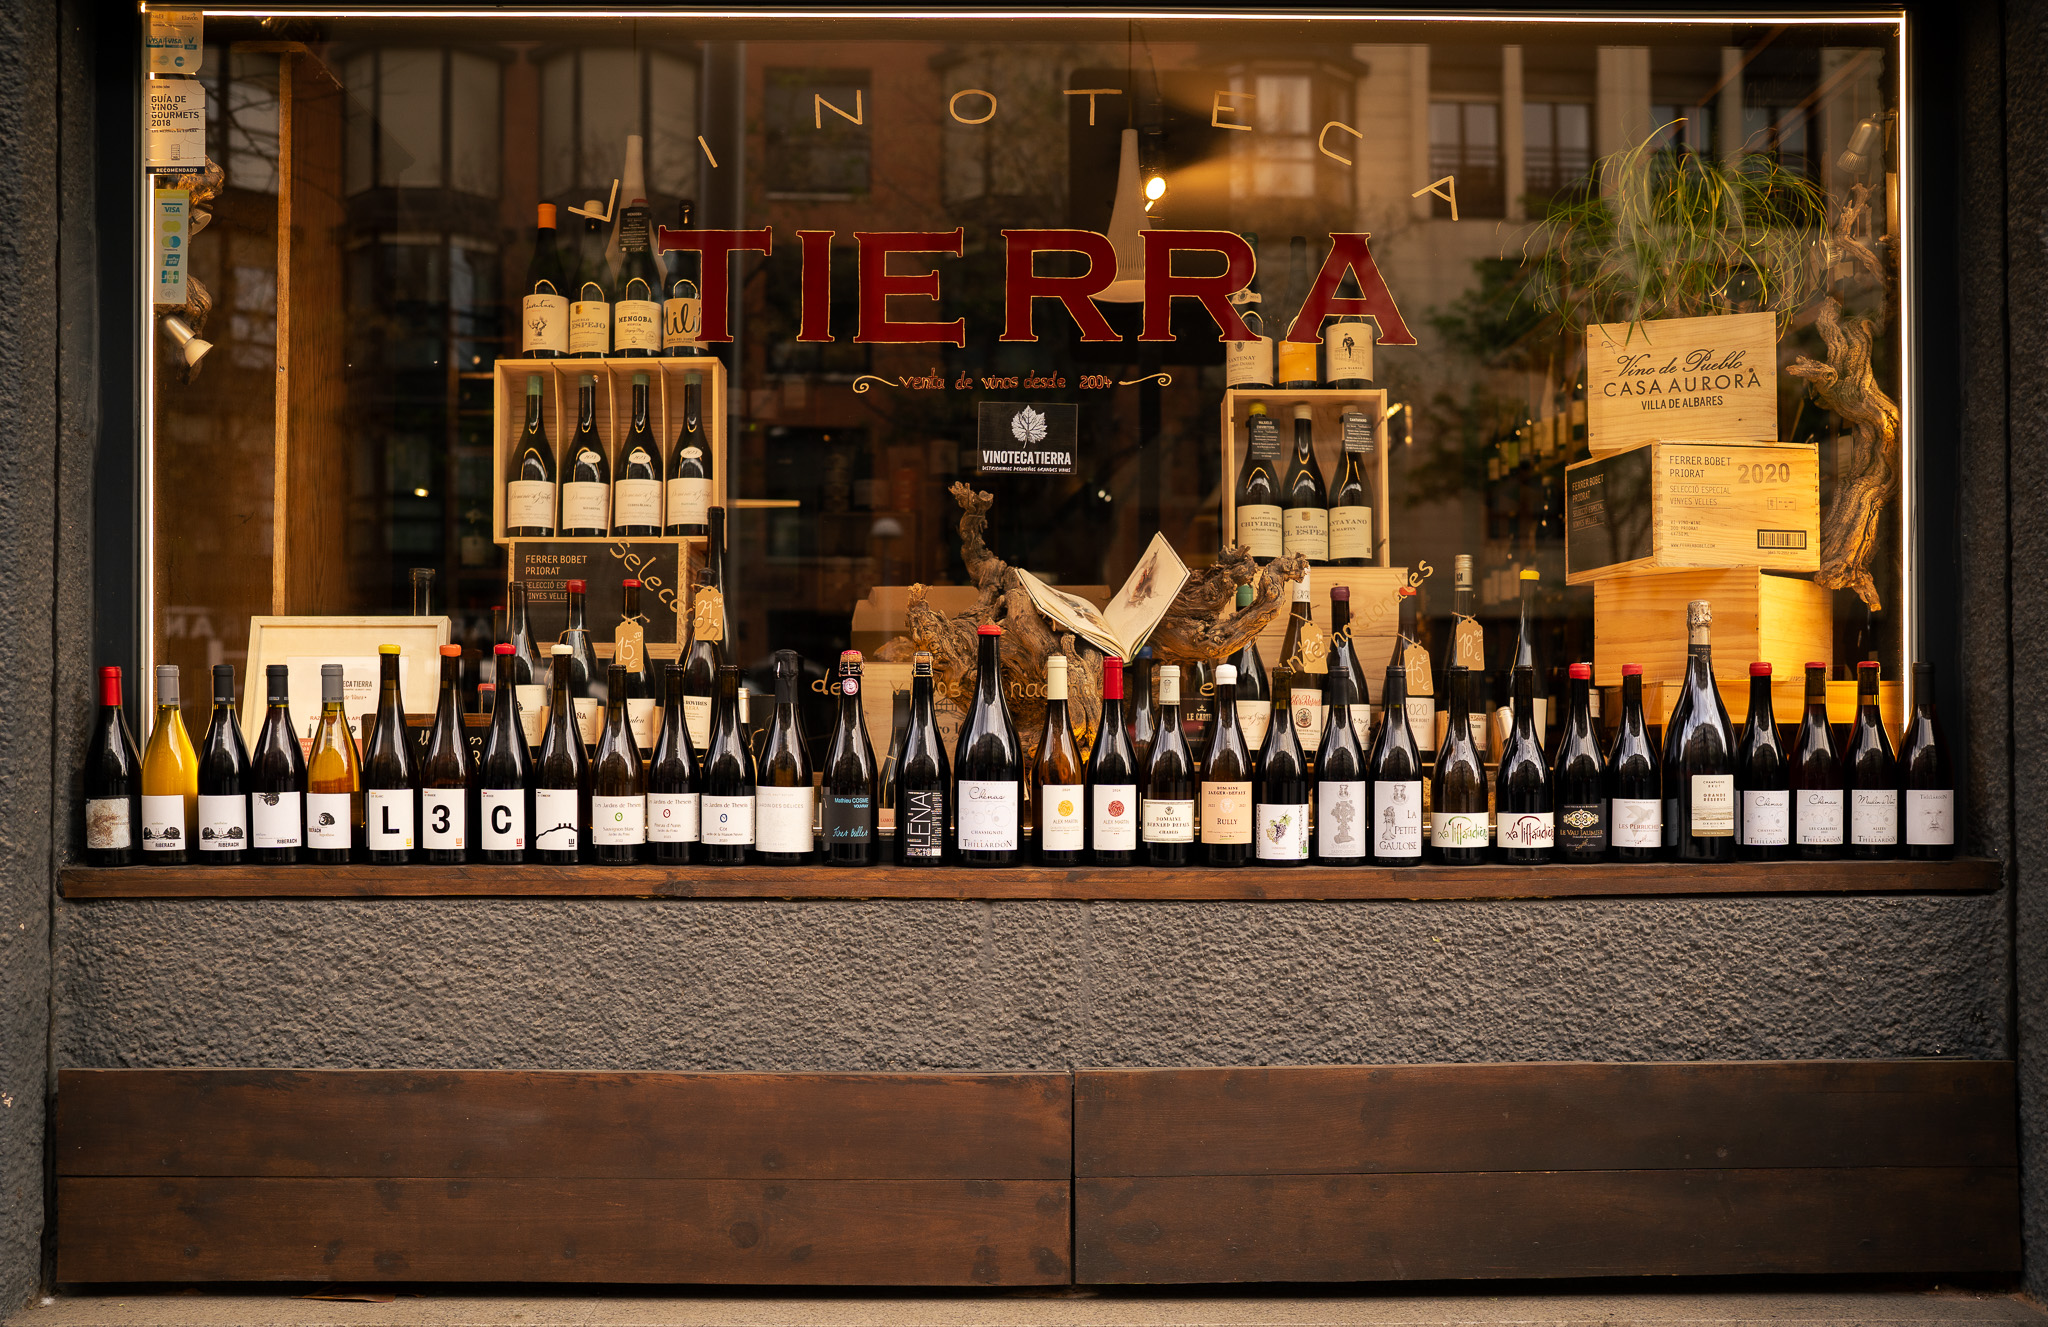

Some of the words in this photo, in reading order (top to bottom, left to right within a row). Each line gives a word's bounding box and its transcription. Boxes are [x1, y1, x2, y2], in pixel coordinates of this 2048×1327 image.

[151, 93, 172, 103] GUÍA
[174, 95, 187, 103] DE
[151, 103, 178, 111] VINOS
[151, 111, 200, 119] GOURMETS
[657, 224, 1418, 349] TIERRA
[618, 315, 653, 324] MENGOBA
[1617, 353, 1655, 377] Vino
[1659, 357, 1678, 374] de
[1682, 349, 1746, 373] Pueblo
[899, 368, 945, 389] venta
[955, 370, 973, 390] de
[981, 374, 1019, 390] vinos
[1023, 369, 1066, 389] desde
[1079, 375, 1113, 390] 2004
[1603, 378, 1663, 397] CASA
[1668, 371, 1761, 394] AURORA
[1641, 400, 1667, 410] VILLA
[1668, 398, 1681, 408] DE
[1682, 395, 1723, 408] ALBARES
[982, 450, 1072, 465] VINOTECATIERRA
[1669, 455, 1703, 466] FERRER
[1704, 456, 1731, 467] BOBET
[1669, 468, 1705, 478] PRIORAT
[1737, 463, 1790, 484] 2020
[1572, 478, 1590, 491] FERRER
[1589, 473, 1604, 487] BOBET
[1669, 485, 1699, 494] SELECCIÓ
[1701, 485, 1731, 495] ESPECIAL
[1669, 497, 1693, 506] VINYES
[1695, 498, 1718, 506] VELLES
[525, 555, 558, 564] FERRER
[560, 555, 587, 564] BOBET
[525, 567, 560, 575] PRIORAT
[549, 592, 568, 600] VELLE
[1186, 713, 1194, 722] LE
[382, 805, 400, 834] L
[431, 804, 451, 834] 3
[491, 804, 512, 834] C
[1394, 826, 1417, 835] PETITE
[962, 838, 1012, 848] THILLARDON
[1379, 841, 1417, 850] GAULOISE
